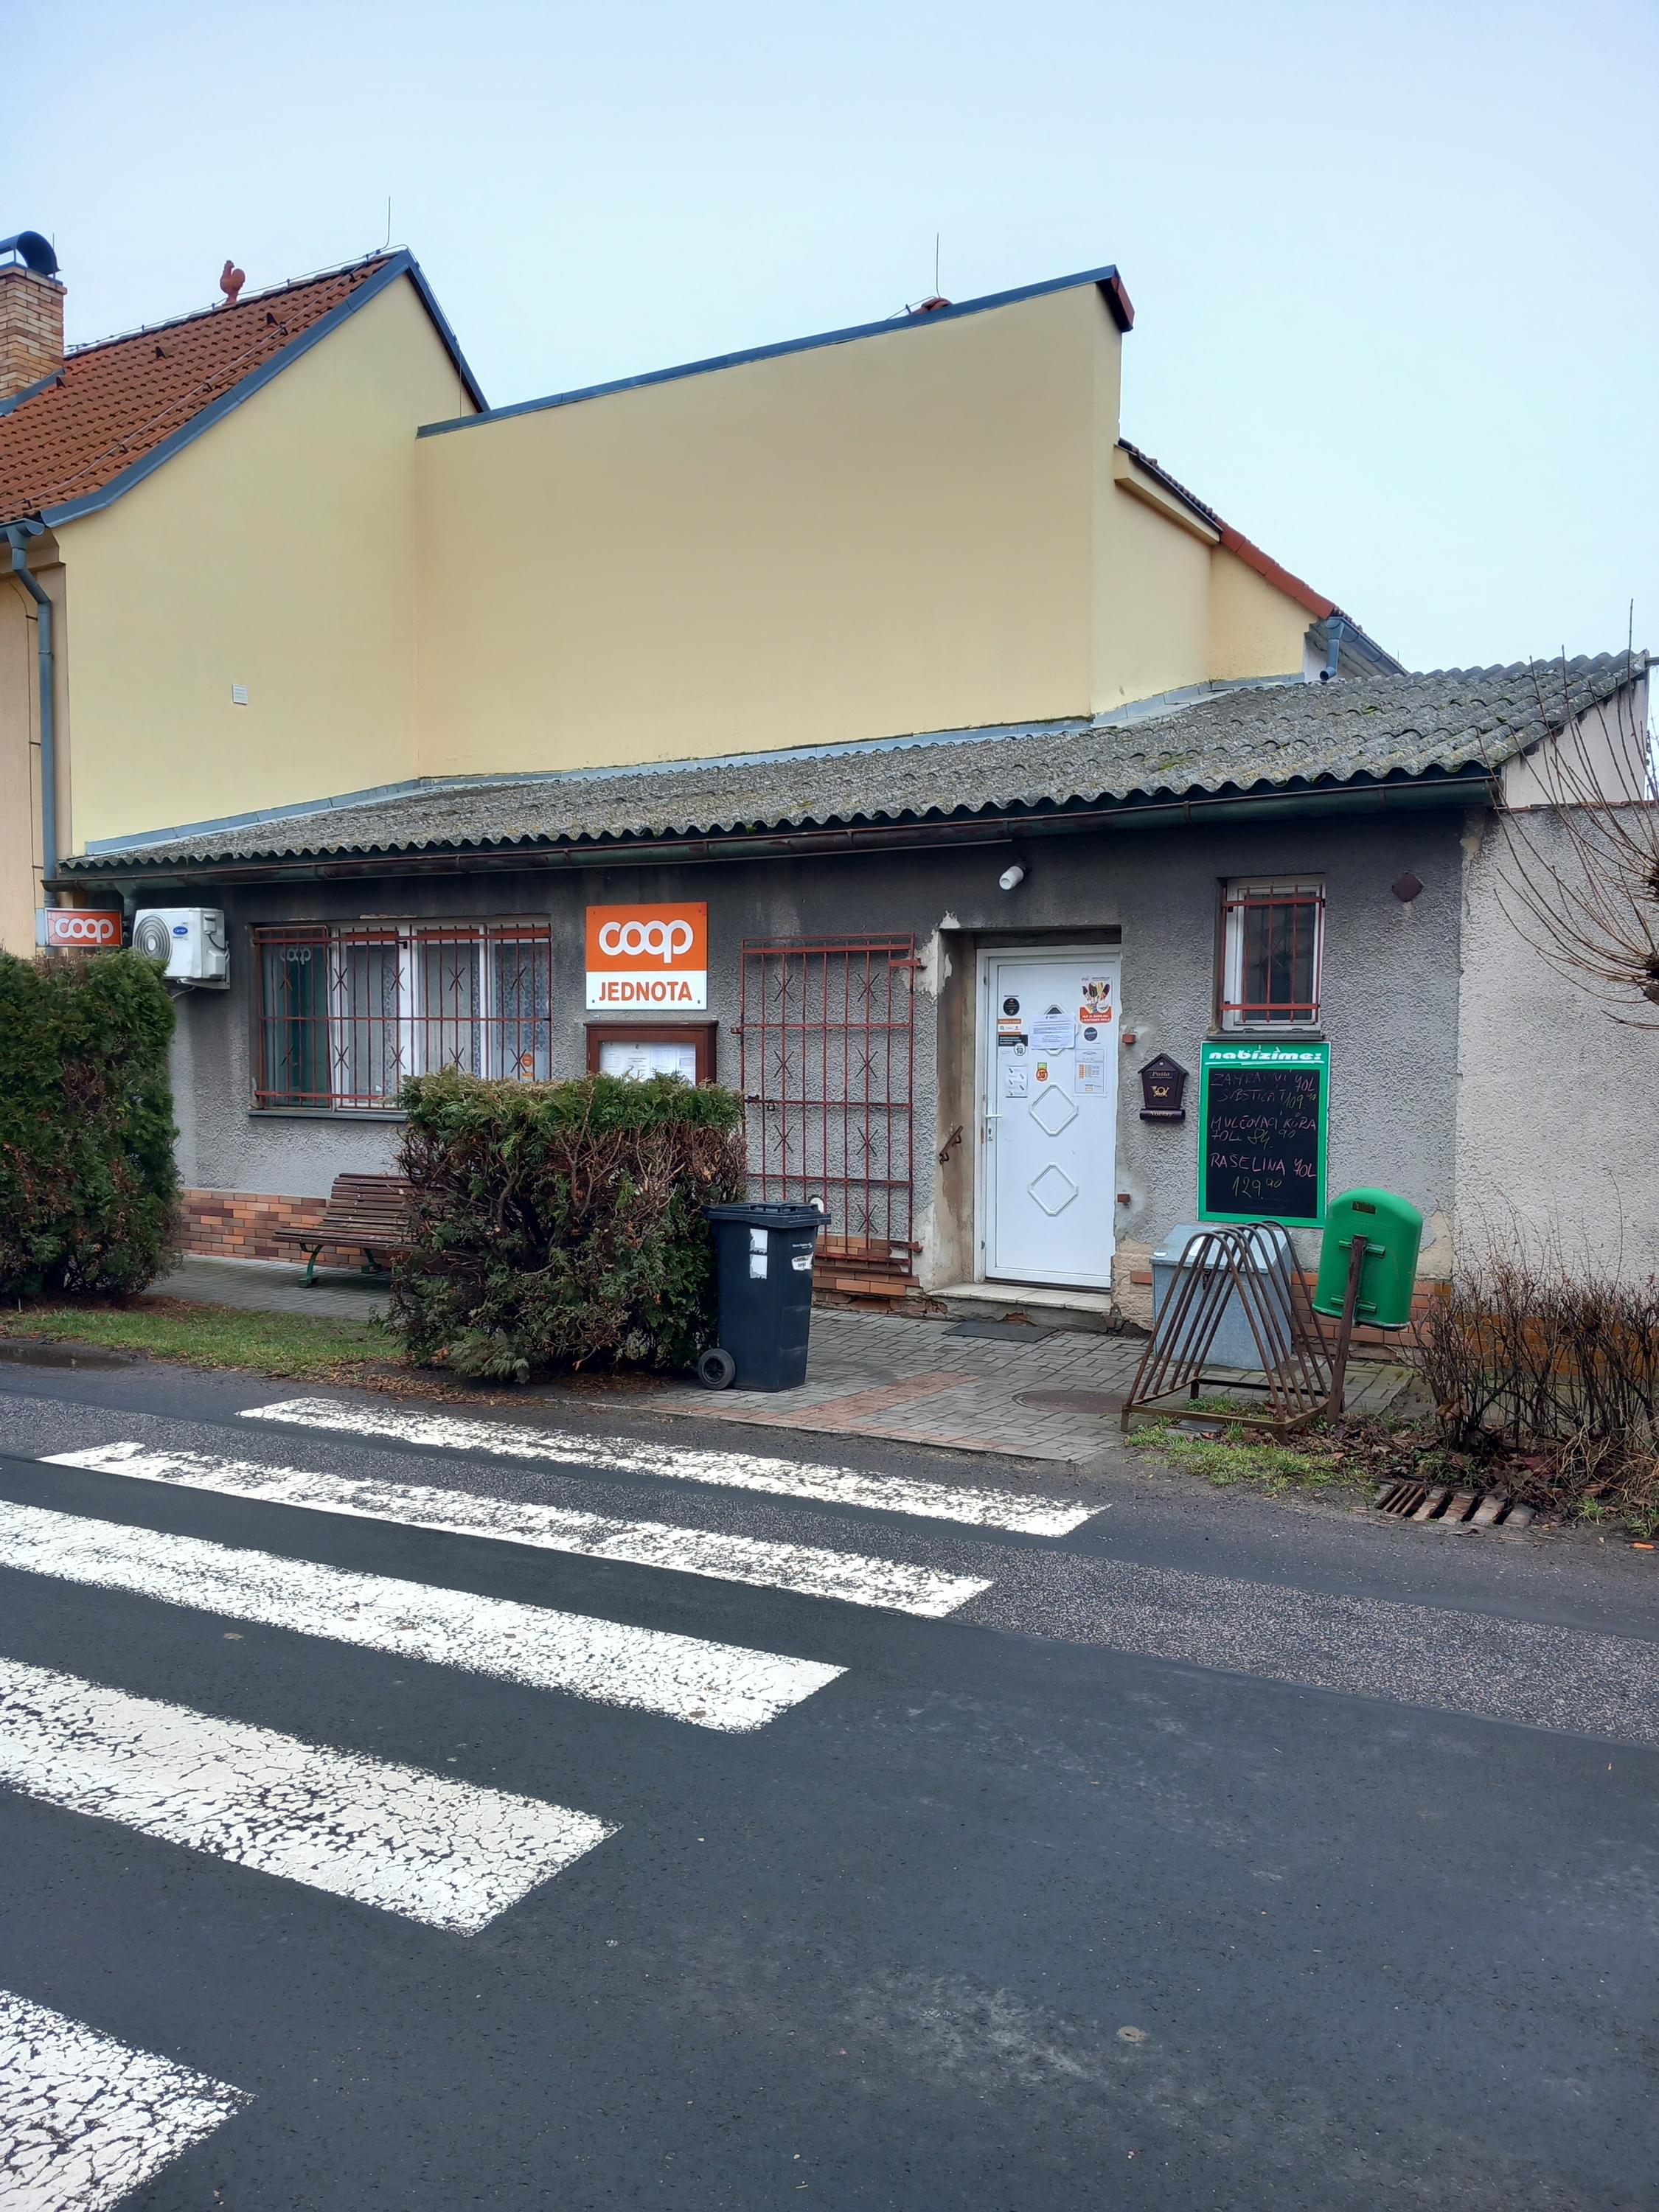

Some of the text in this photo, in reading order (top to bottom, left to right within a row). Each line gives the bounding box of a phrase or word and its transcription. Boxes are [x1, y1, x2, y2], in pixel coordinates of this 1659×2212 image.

[55, 917, 114, 943] coop
[598, 919, 694, 964] coop
[599, 981, 693, 1001] JEDNOTA
[1294, 1158, 1317, 1178] 70L
